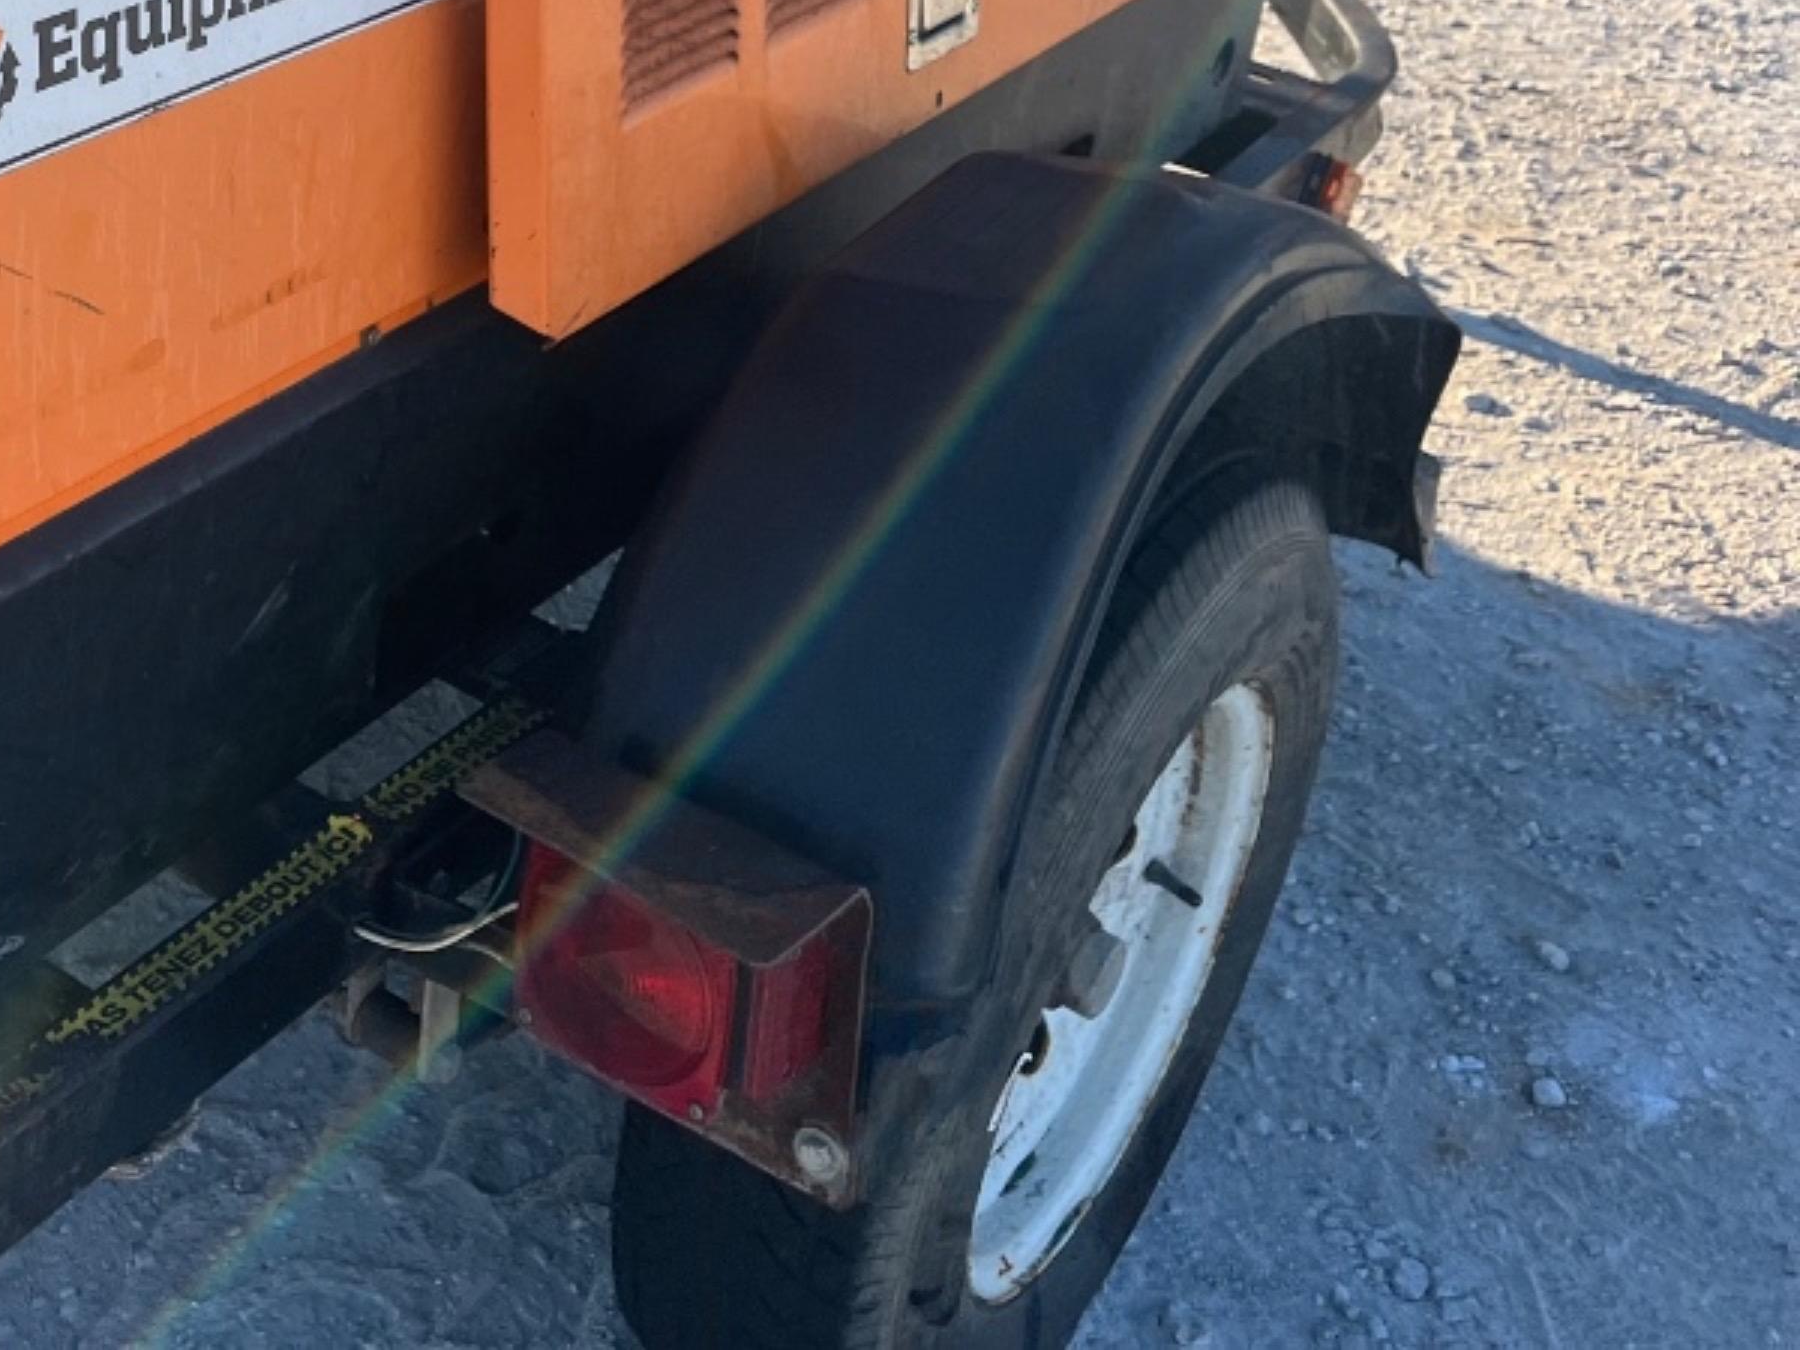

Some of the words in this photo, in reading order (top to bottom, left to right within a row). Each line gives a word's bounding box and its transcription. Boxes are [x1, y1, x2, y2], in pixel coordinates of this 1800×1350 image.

[123, 937, 216, 1001] TENEZ
[212, 860, 317, 939] DEBOUT
[318, 827, 359, 862] ICI
